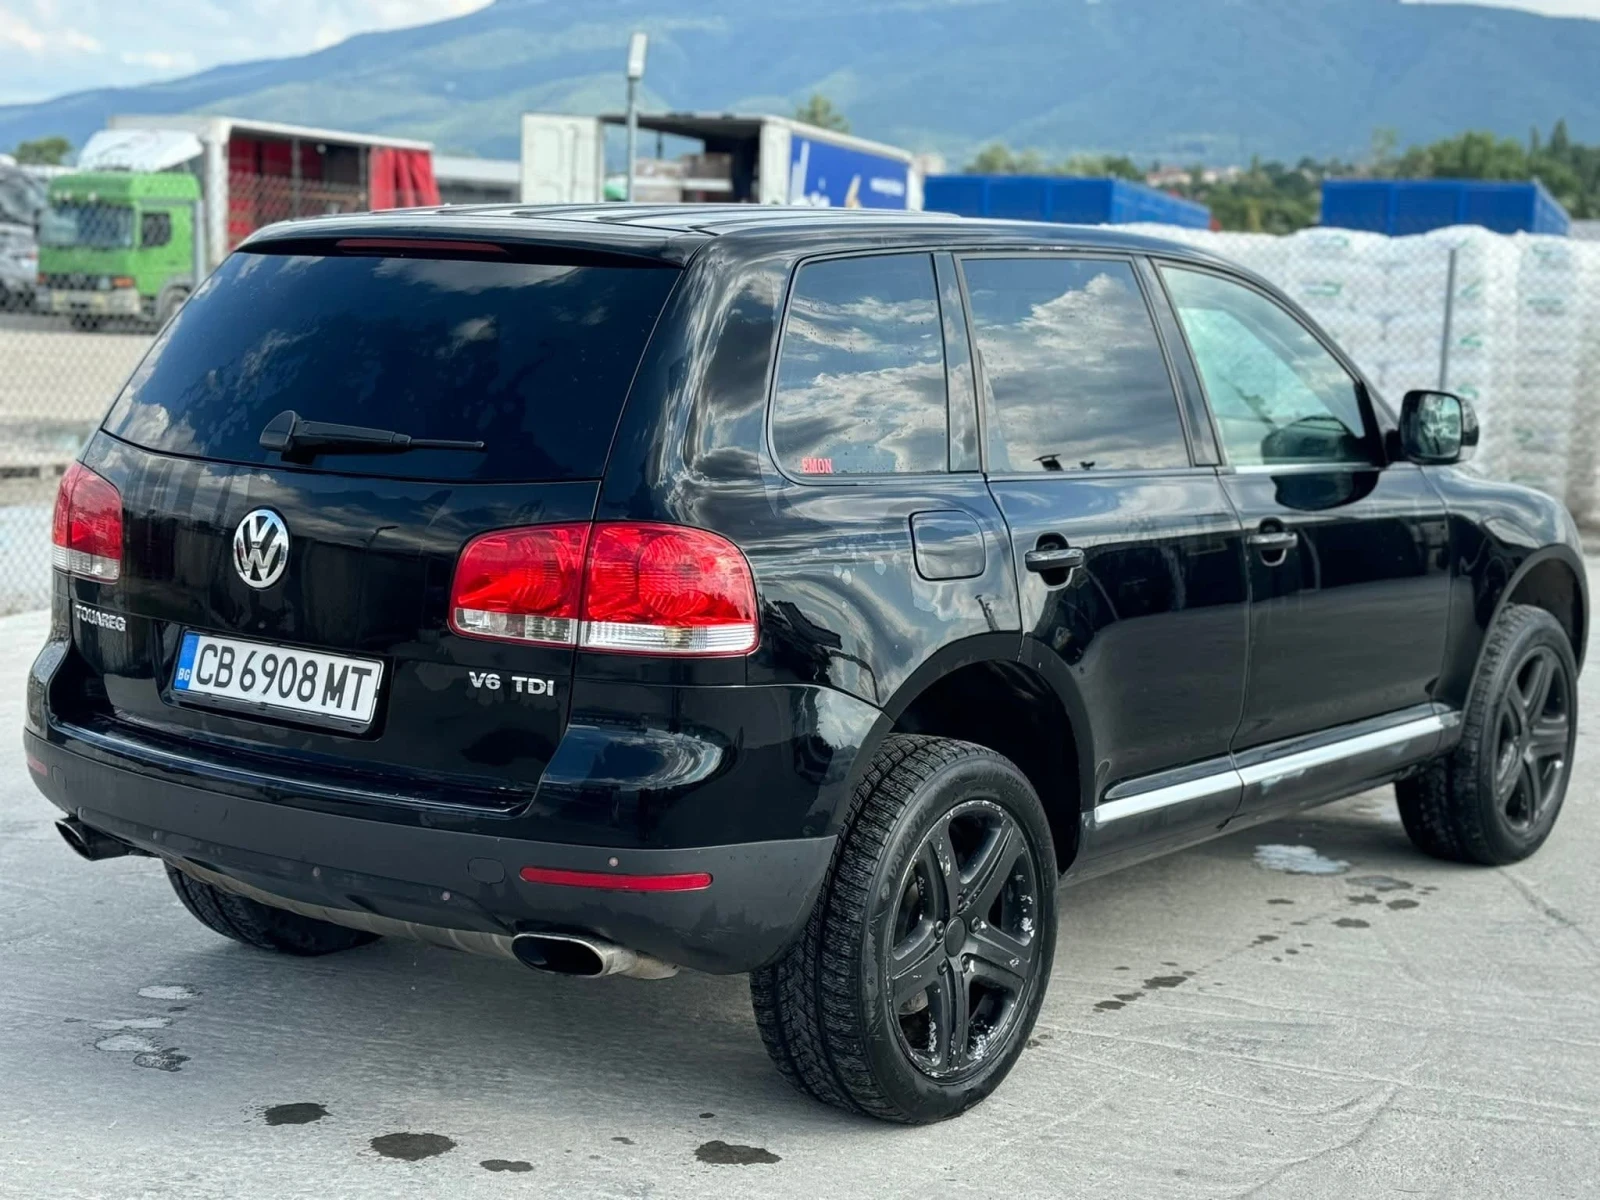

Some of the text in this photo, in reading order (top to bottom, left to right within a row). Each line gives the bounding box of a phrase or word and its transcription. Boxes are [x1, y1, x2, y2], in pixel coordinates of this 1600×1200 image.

[233, 509, 289, 588] VW
[75, 604, 127, 632] TOUAREG
[177, 667, 191, 682] BG
[468, 671, 555, 697] V6 TDI
